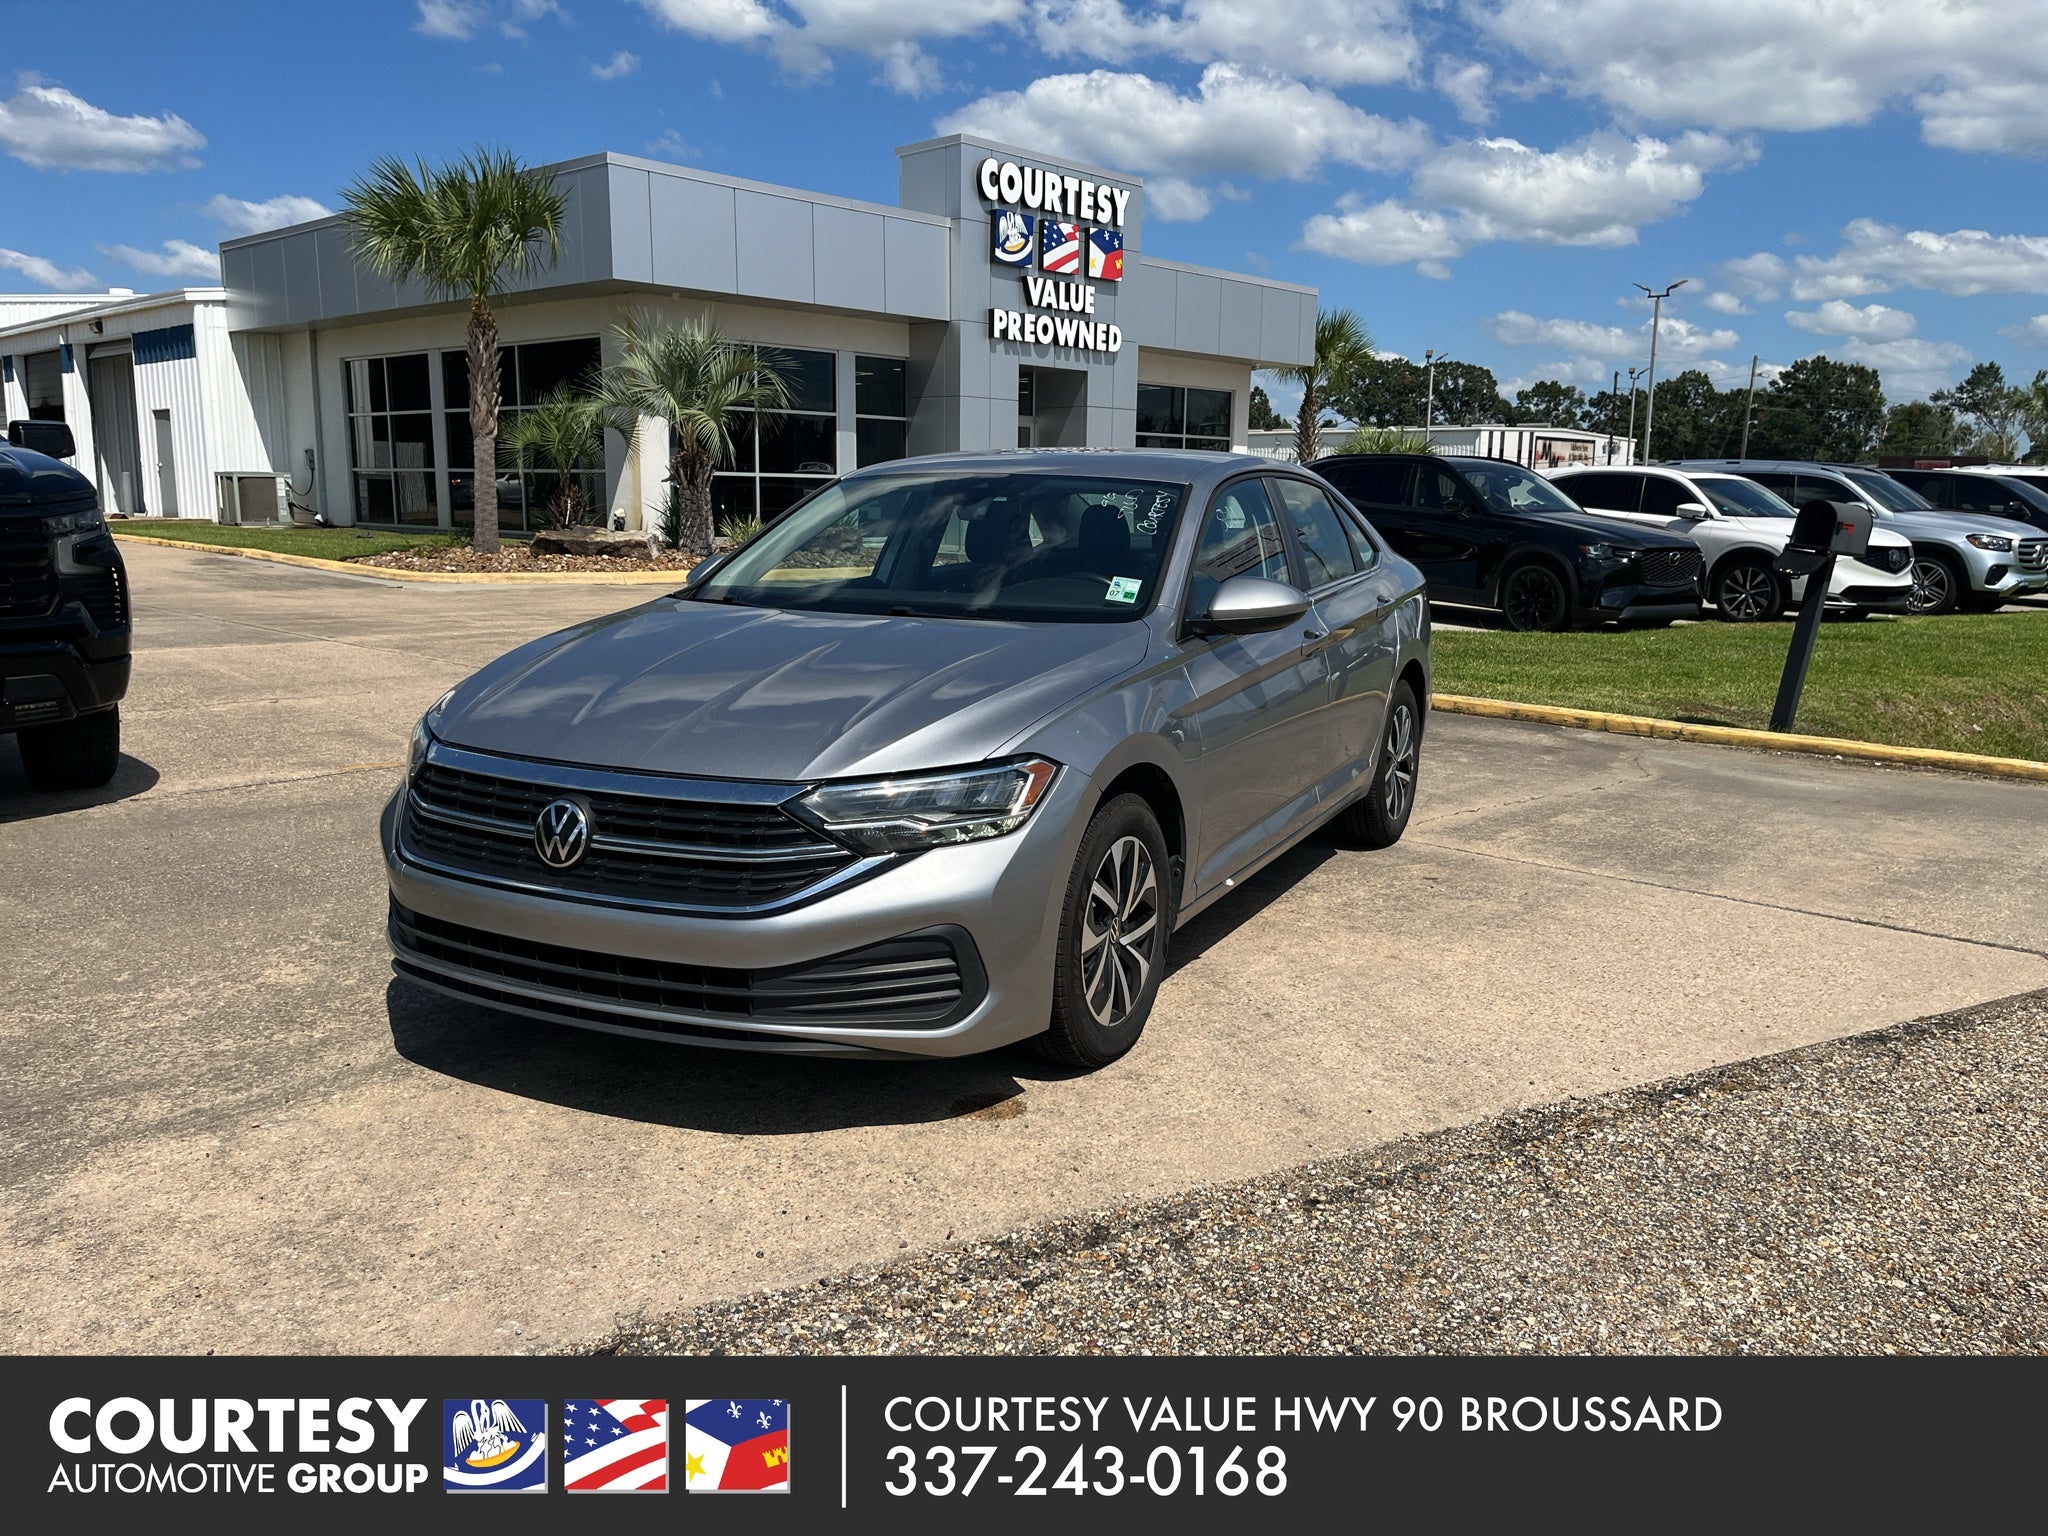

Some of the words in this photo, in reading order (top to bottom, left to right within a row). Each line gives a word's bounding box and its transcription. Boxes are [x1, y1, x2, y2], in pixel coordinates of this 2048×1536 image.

[980, 157, 1131, 227] COURTESY
[1026, 275, 1096, 314] VALUE
[992, 308, 1122, 353] PREOWNED
[1110, 589, 1120, 597] 07
[537, 801, 586, 866] VW
